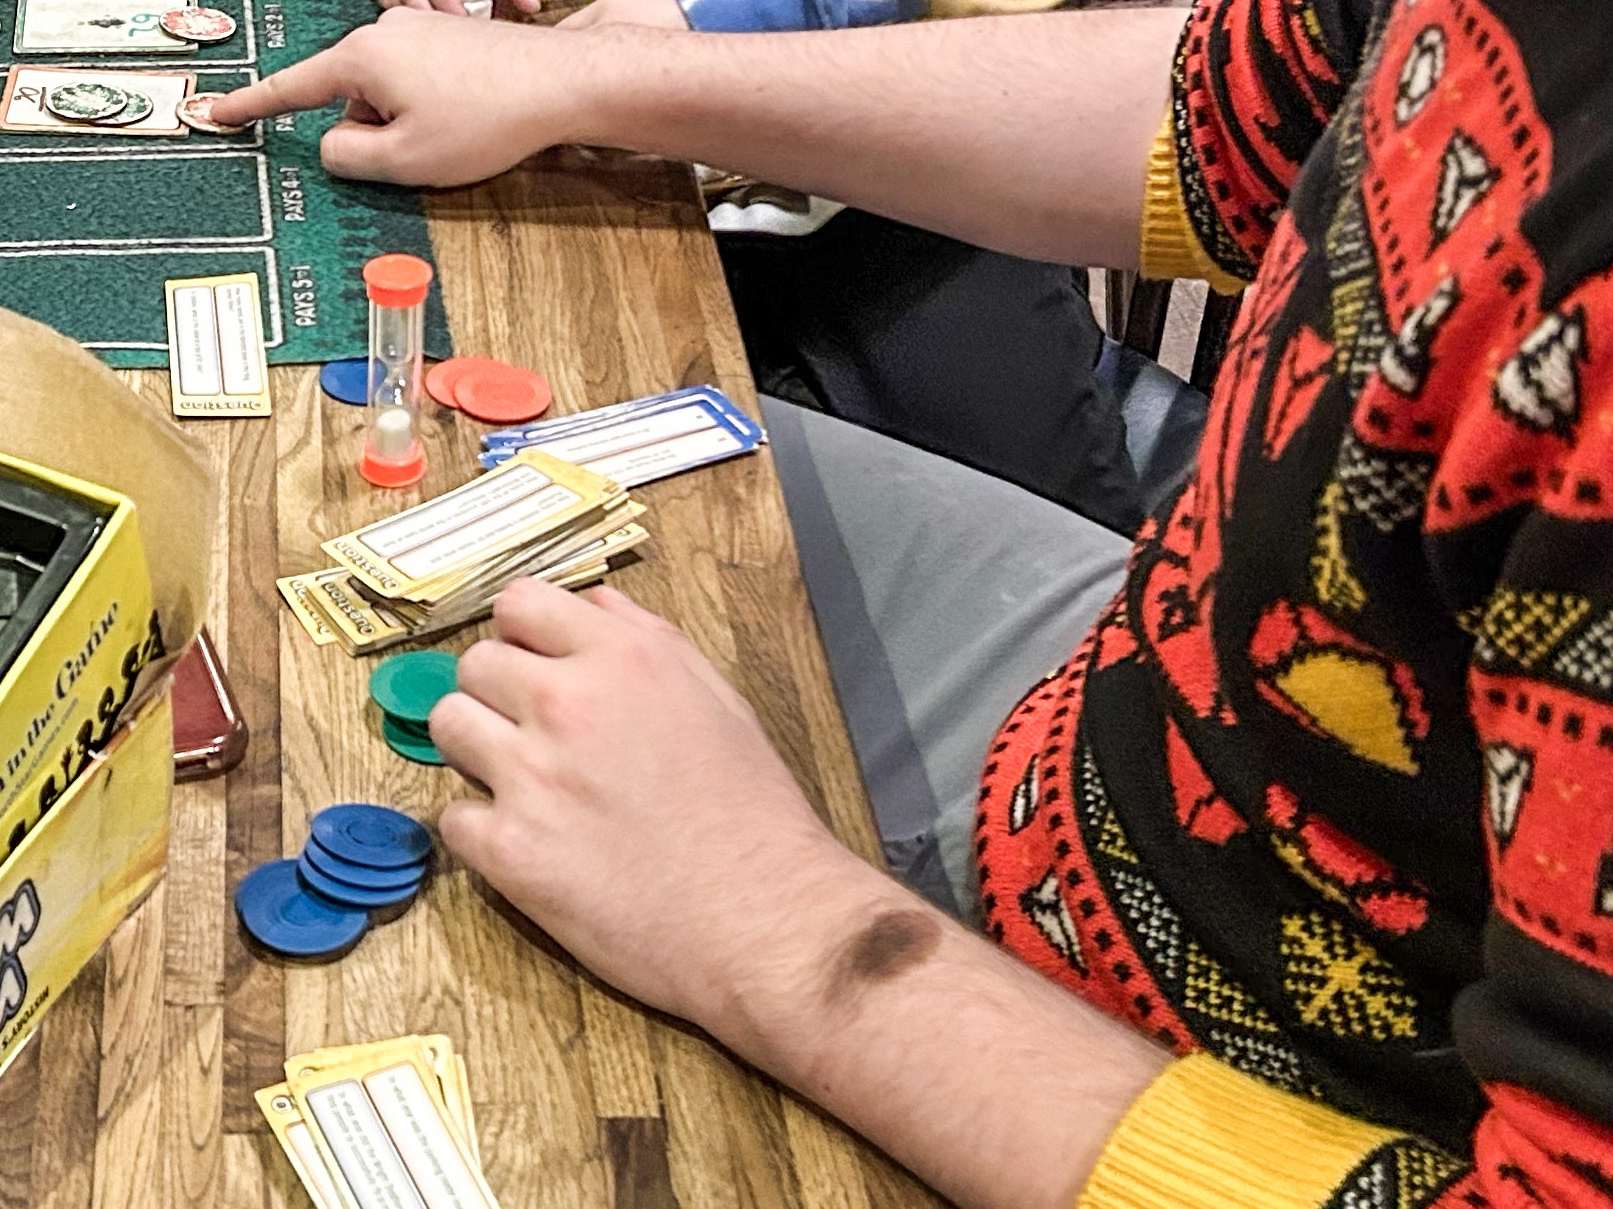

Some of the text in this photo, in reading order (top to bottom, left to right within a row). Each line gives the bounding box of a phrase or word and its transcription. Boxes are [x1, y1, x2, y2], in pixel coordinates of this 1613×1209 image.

[265, 23, 285, 48] PAYS
[282, 190, 306, 222] PAYS
[293, 292, 316, 326] PAYS
[335, 541, 399, 590] Question
[321, 580, 375, 636] Question
[6, 746, 29, 778] in
[26, 702, 56, 747] the
[55, 601, 119, 700] Game
[1, 985, 50, 1049] HISTORY'S
